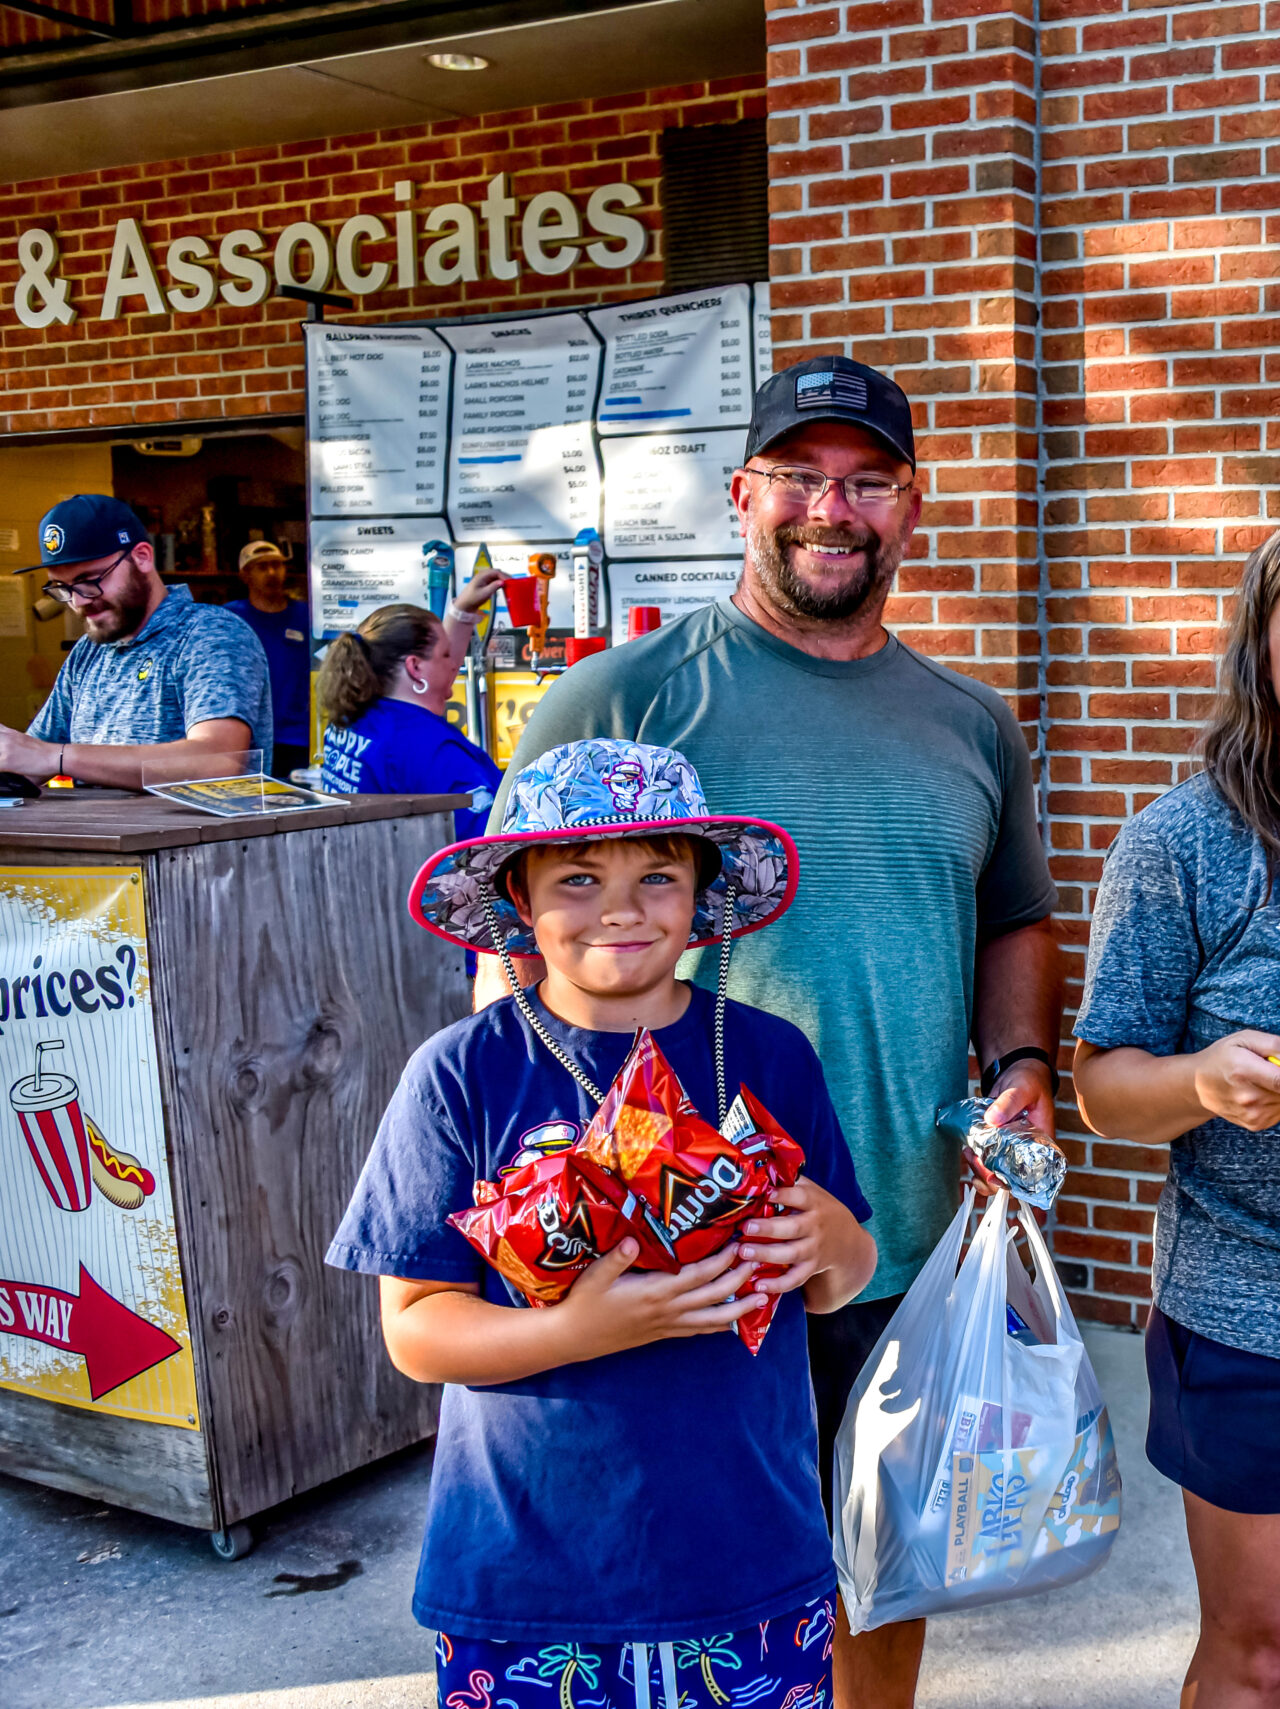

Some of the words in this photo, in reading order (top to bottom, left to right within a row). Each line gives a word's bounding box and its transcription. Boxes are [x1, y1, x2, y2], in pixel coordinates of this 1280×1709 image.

[13, 228, 78, 328] &
[100, 172, 650, 320] Associates
[618, 307, 657, 322] THIRST
[659, 297, 722, 317] QUENCHERS
[674, 443, 706, 454] DRAFT
[357, 526, 394, 536] SWEETS
[634, 573, 678, 583] CANNED
[681, 571, 736, 582] COCKTAILS
[15, 1290, 73, 1344] WAY
[954, 1477, 969, 1547] PLAYBALL
